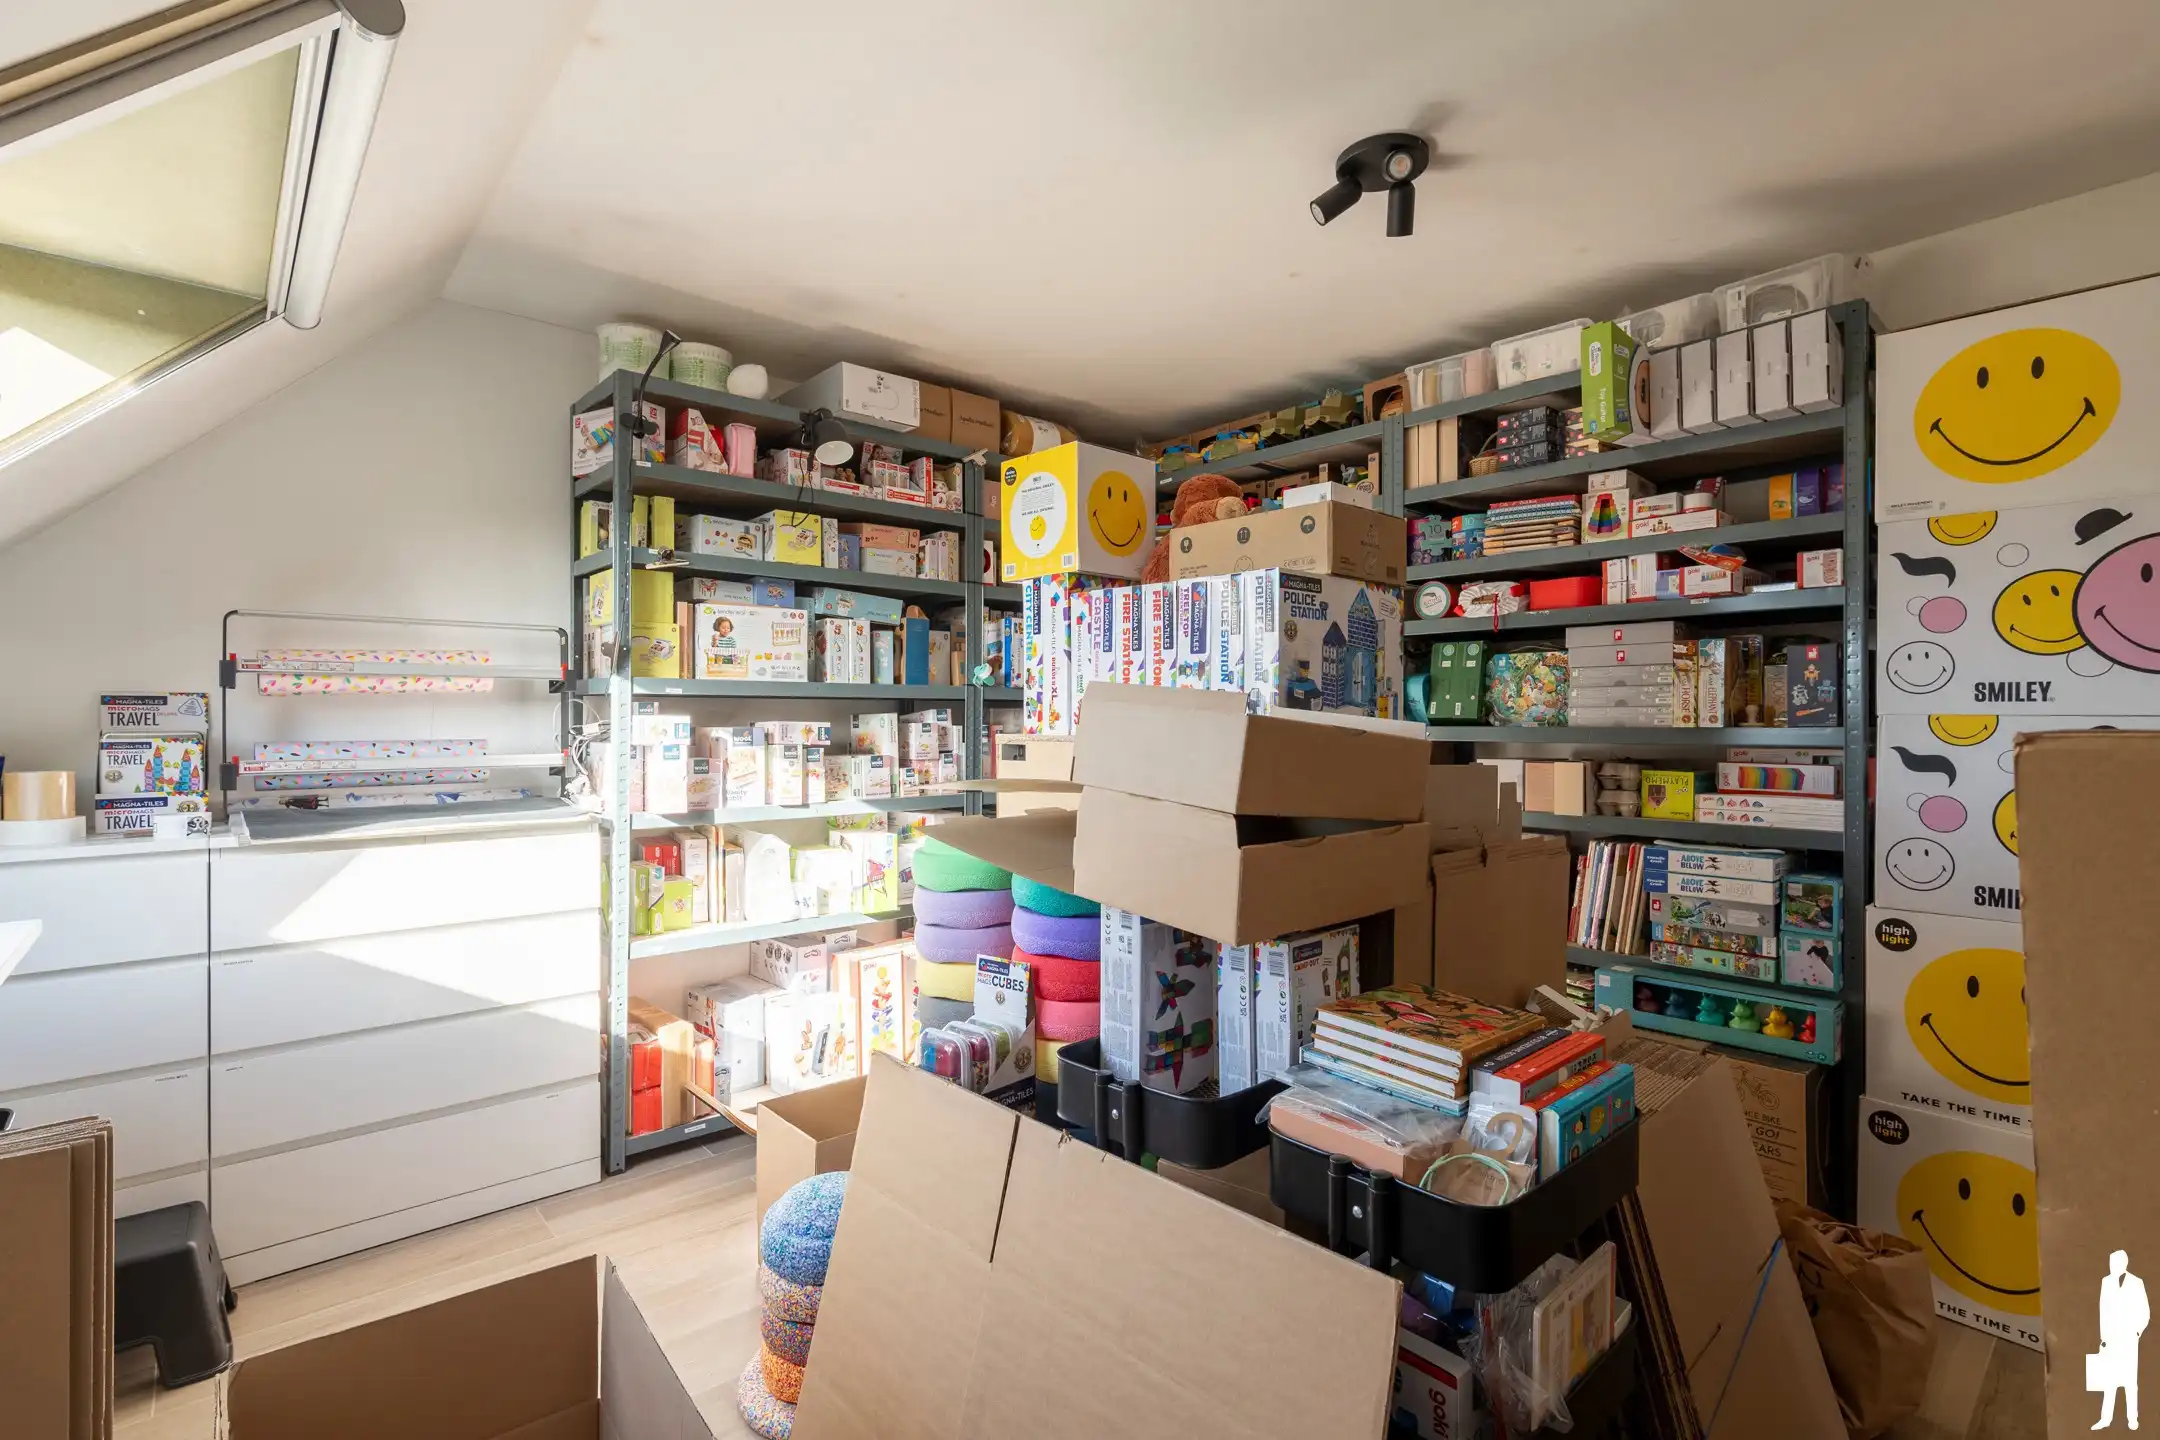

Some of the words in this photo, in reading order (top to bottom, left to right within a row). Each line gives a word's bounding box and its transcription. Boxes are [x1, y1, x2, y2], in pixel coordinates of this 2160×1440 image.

[1464, 517, 1474, 526] 10
[1635, 520, 1649, 529] goki
[1429, 525, 1441, 534] 10
[1288, 580, 1321, 592] MAGNA-TILES
[1025, 585, 1033, 613] CITY
[1153, 590, 1161, 622] FIRE
[1221, 580, 1230, 627] POLICE
[1255, 575, 1263, 624] POLICE
[1284, 591, 1316, 606] POLICE
[1290, 605, 1328, 620] STATION
[1025, 614, 1033, 662] CENTER
[1122, 627, 1133, 684] STATION
[1153, 625, 1164, 686] STATION
[1221, 629, 1229, 682] STATION
[1255, 627, 1263, 682] STATION
[1974, 681, 2052, 703] SMILEY
[1681, 687, 1691, 713] HORSE
[1708, 687, 1717, 716] ELEPHANT
[107, 712, 160, 727] TRAVEL
[107, 755, 145, 766] TRAVEL
[1643, 775, 1689, 785] PLAYMEMO
[113, 800, 164, 808] MAGNA-TILES
[105, 814, 153, 830] TRAVEL
[1681, 855, 1704, 863] ABOVE
[1681, 861, 1704, 870] BELOW
[1681, 877, 1704, 885] ABOVE
[1680, 885, 1703, 893] BELOW
[1882, 923, 1910, 936] high
[1881, 933, 1910, 945] light
[991, 975, 1024, 992] CUBES
[1901, 1092, 1941, 1108] TAKE
[1946, 1101, 1977, 1116] THE
[1983, 1109, 2021, 1125] TIME
[1762, 1113, 1782, 1126] BIKE
[1875, 1116, 1903, 1129] high
[1874, 1125, 1903, 1140] light
[1937, 1300, 1967, 1318] THE
[1973, 1313, 2011, 1334] TIME
[2018, 1329, 2040, 1343] TO
[1428, 1387, 1450, 1440] goki
